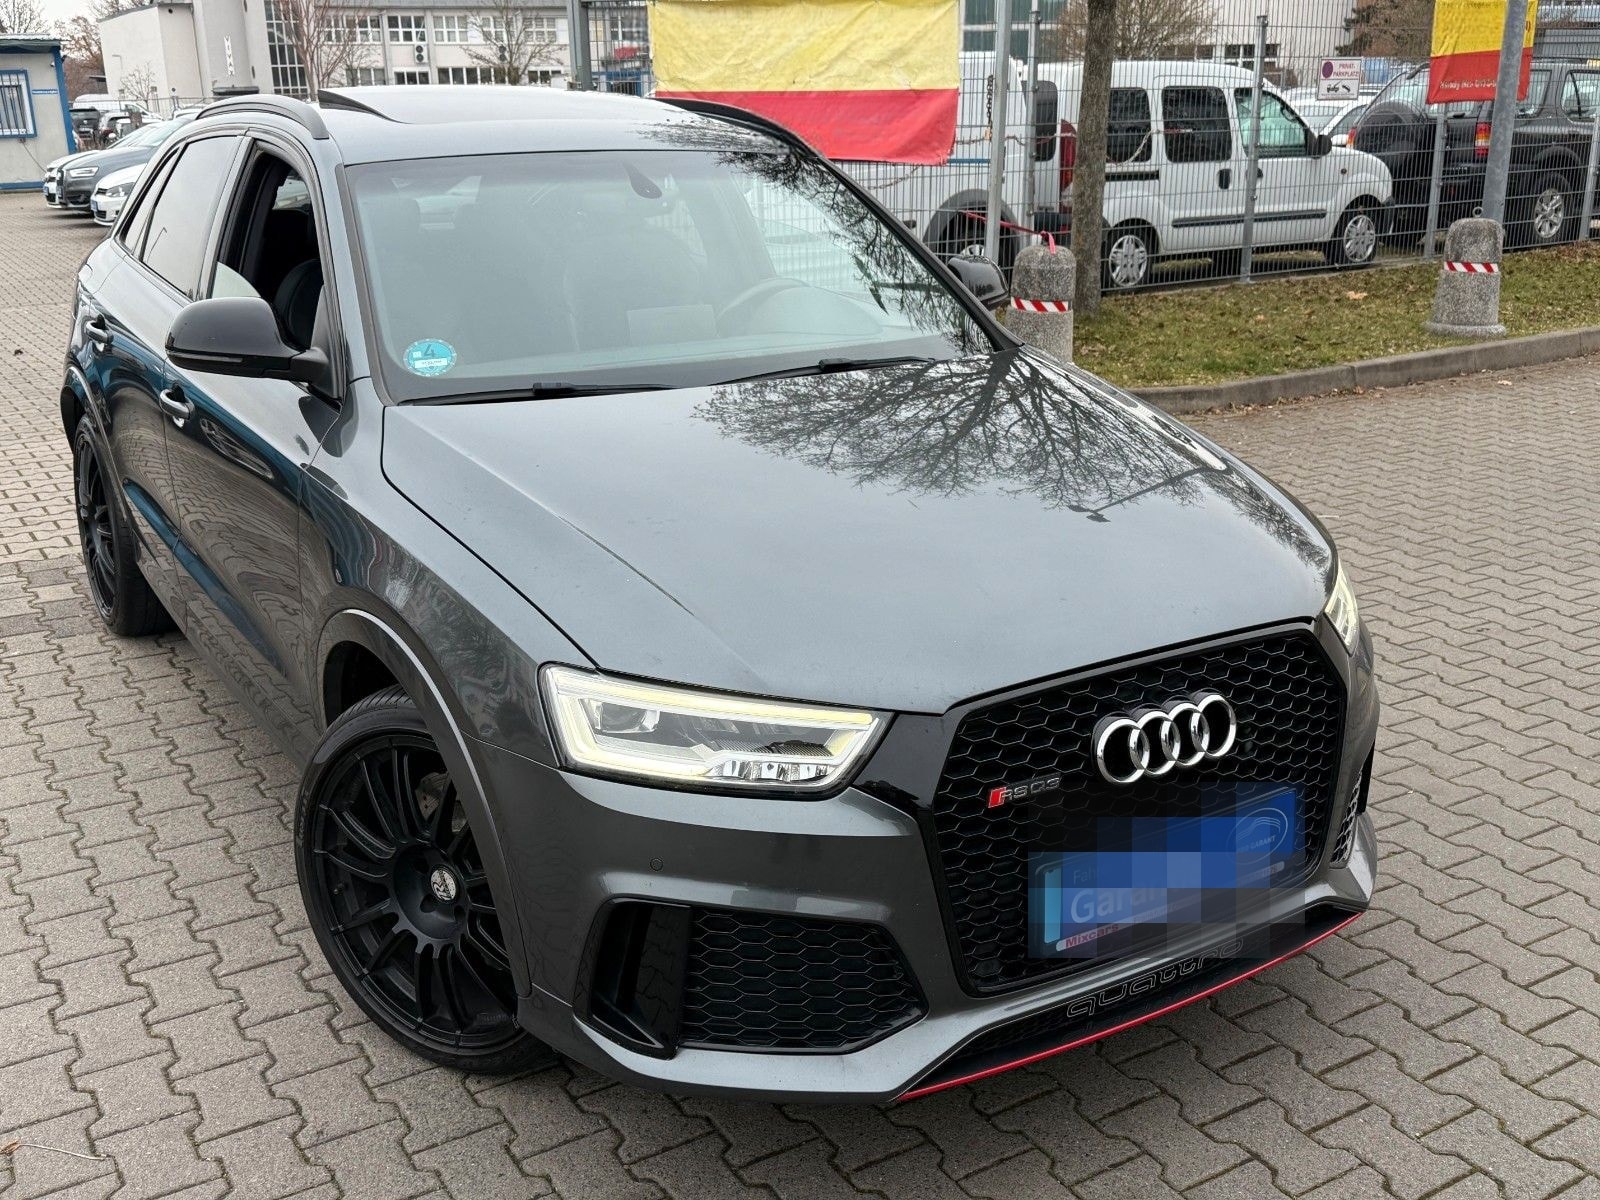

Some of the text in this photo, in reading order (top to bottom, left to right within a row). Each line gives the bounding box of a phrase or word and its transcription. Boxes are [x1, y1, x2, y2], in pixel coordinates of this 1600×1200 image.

[423, 344, 436, 358] 4
[1065, 923, 1119, 949] Mixcars
[1066, 938, 1244, 1019] quattro
